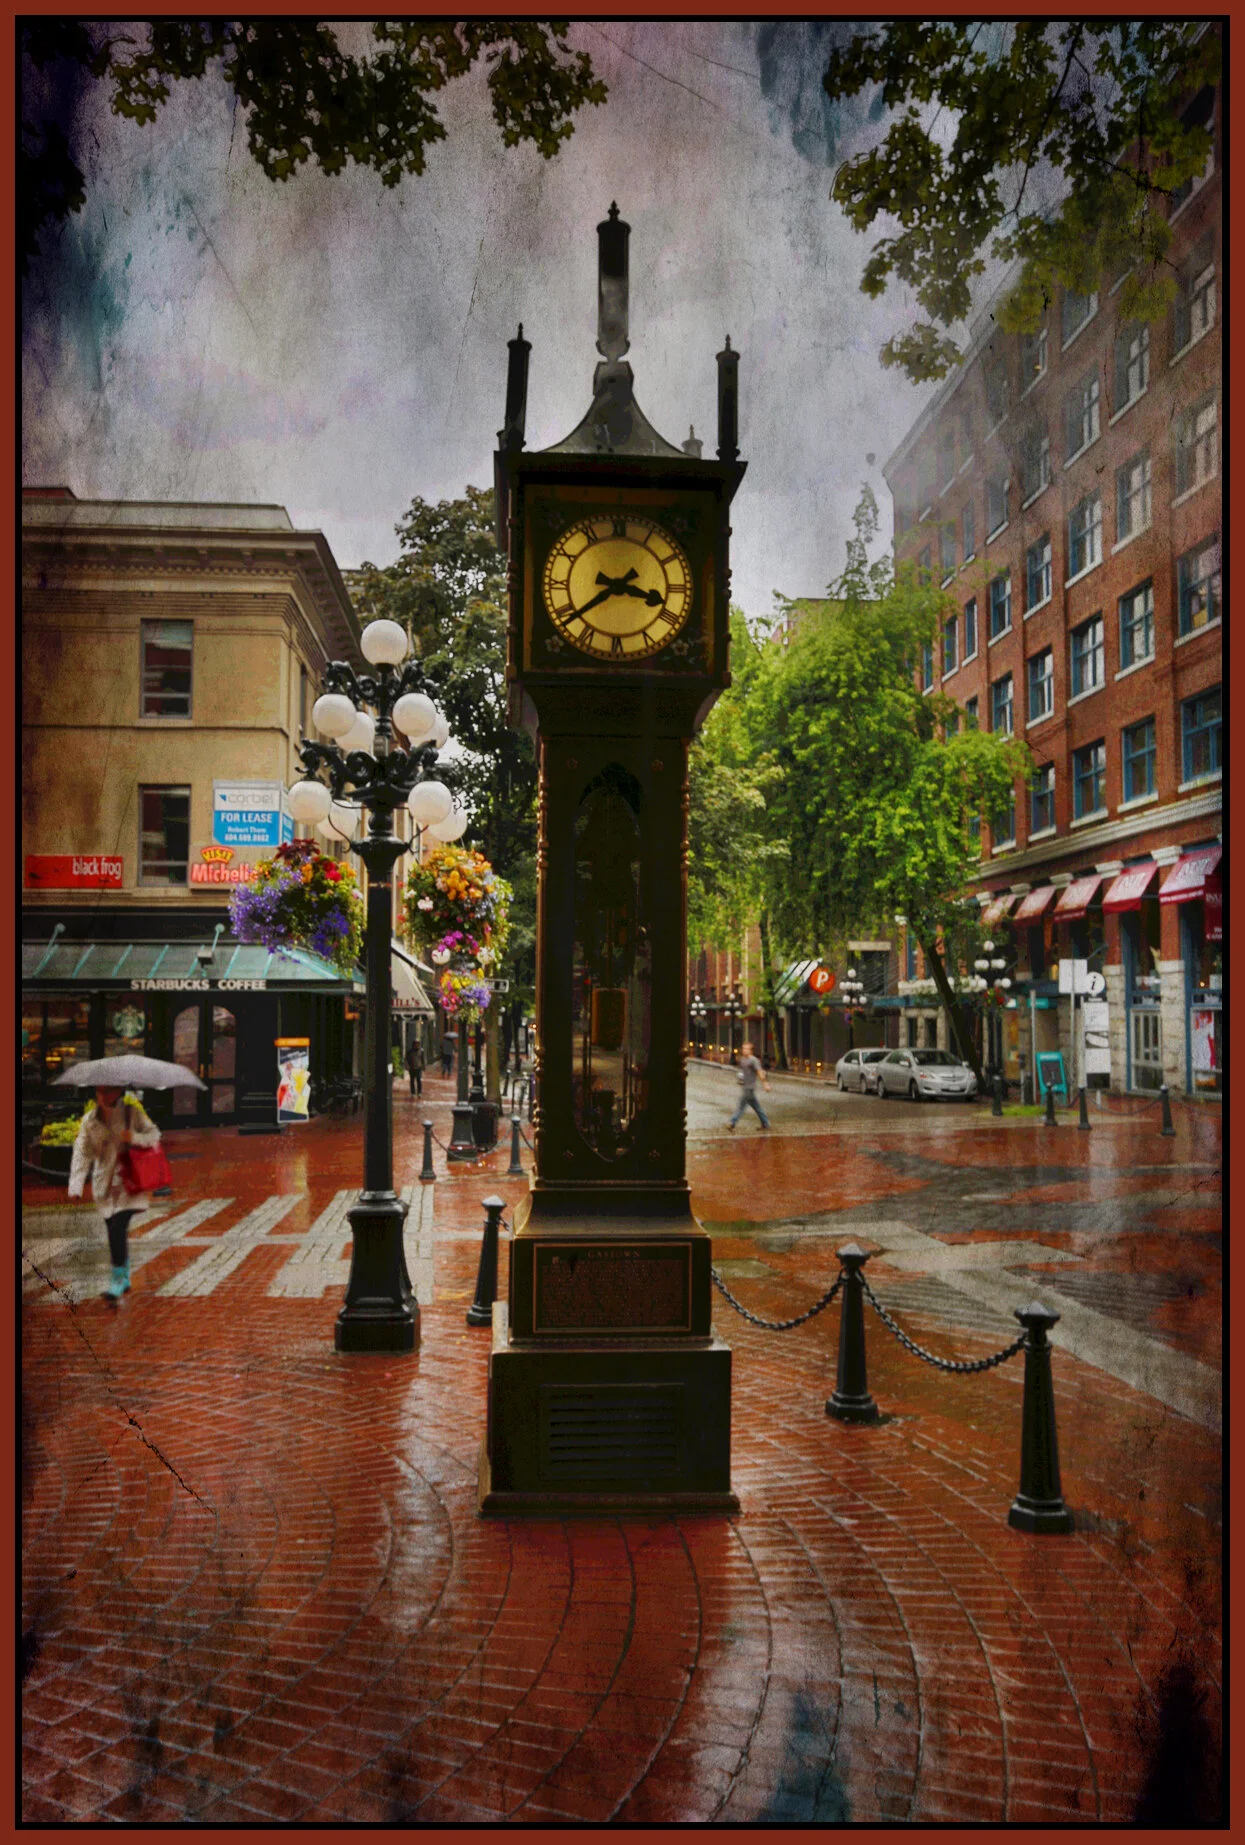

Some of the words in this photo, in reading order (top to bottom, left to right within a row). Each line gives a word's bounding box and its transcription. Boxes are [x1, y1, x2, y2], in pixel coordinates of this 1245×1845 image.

[557, 548, 578, 565] X
[667, 583, 686, 593] III
[642, 631, 657, 648] V
[220, 812, 241, 823] FOR
[242, 812, 273, 823] LEASE
[202, 847, 235, 861] VISIT
[72, 857, 99, 876] black
[101, 856, 122, 880] frog
[131, 979, 210, 990] STARBUCKS
[218, 979, 267, 990] COFFEE
